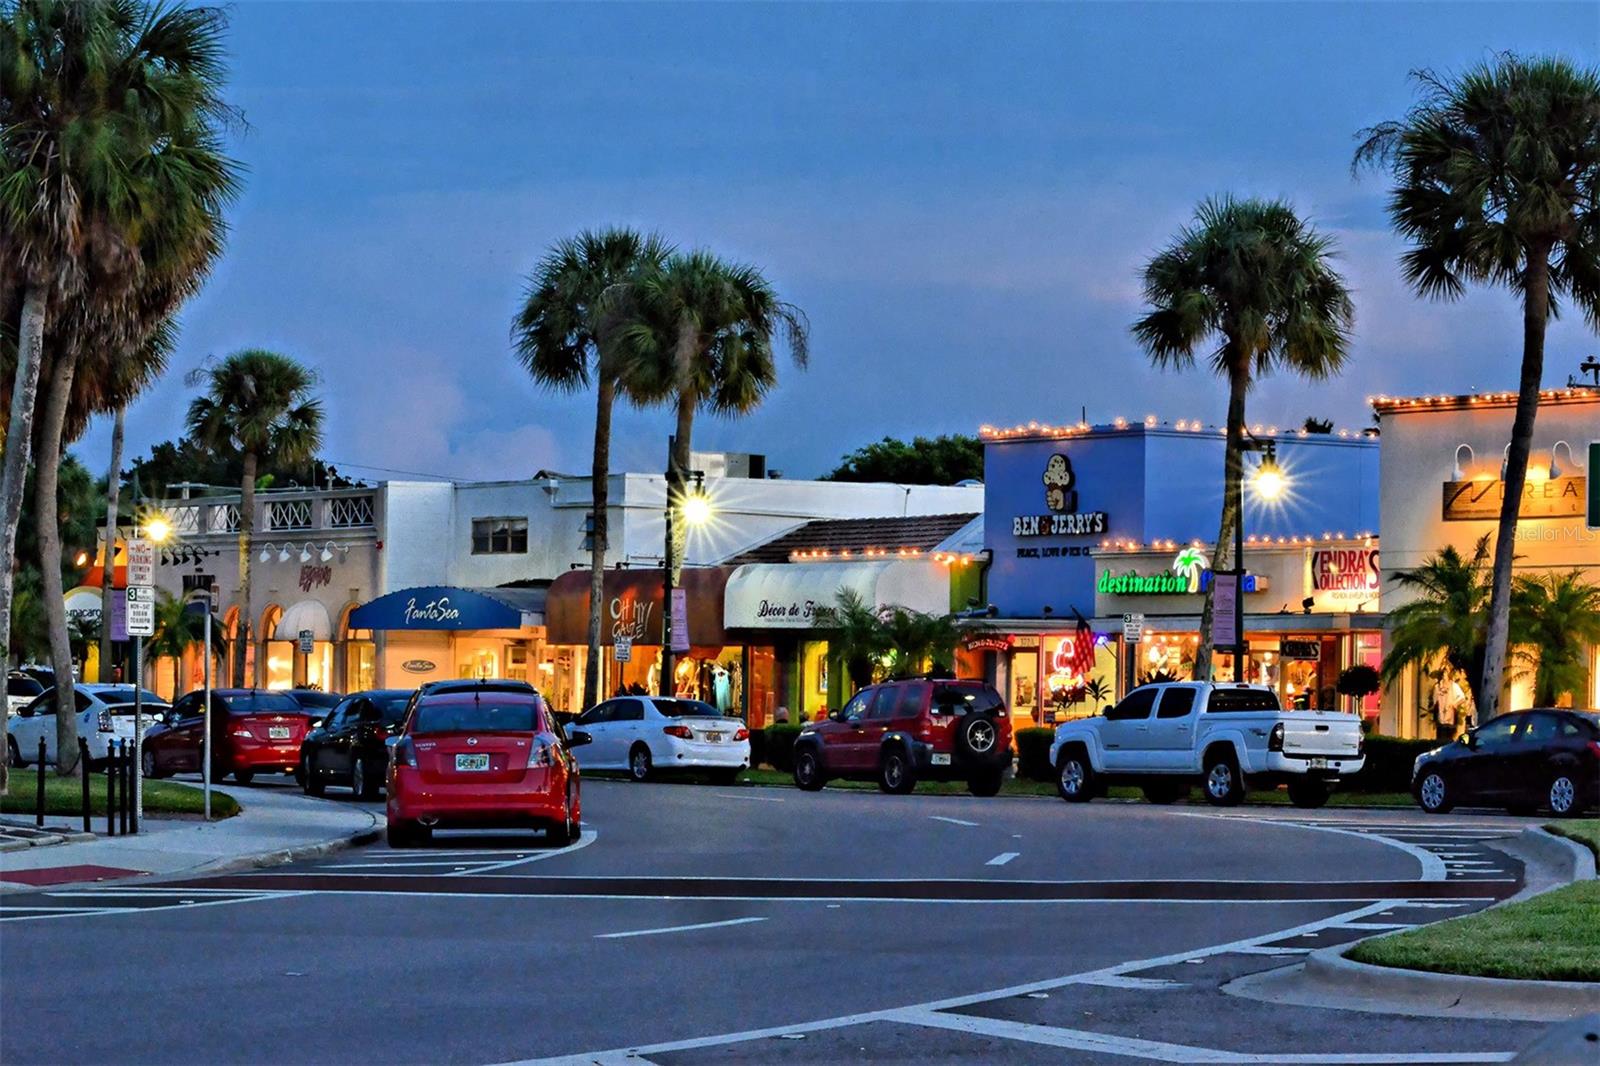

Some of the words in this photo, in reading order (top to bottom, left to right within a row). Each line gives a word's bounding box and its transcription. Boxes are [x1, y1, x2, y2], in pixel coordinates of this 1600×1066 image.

[1013, 516, 1040, 536] BEN
[1051, 512, 1103, 534] JERRY'S
[136, 544, 145, 553] NO
[129, 555, 151, 565] PARKING
[1099, 569, 1187, 593] destination
[129, 588, 136, 600] 3
[610, 598, 629, 620] OH
[788, 602, 799, 616] de
